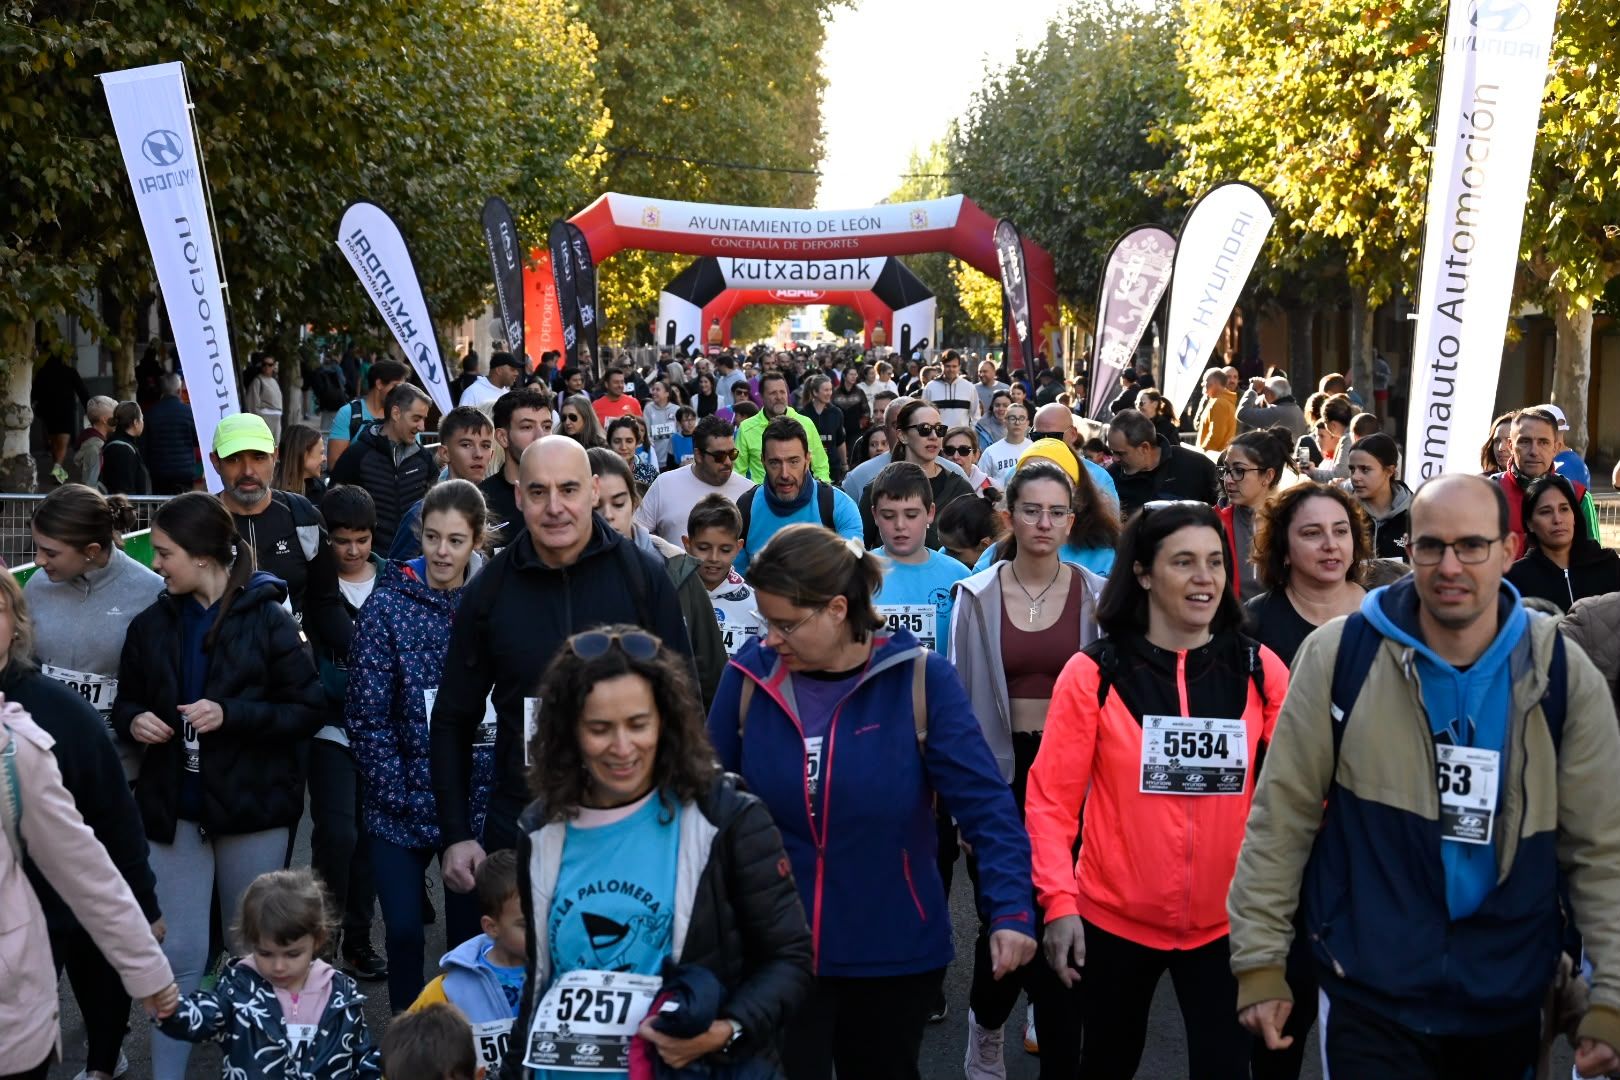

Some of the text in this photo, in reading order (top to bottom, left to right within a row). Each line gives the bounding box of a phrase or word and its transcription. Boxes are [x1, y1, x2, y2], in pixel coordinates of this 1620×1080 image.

[688, 215, 881, 234] AYUNTAMIENTO DE LEÓN
[711, 237, 859, 250] CONCEJALÍA DE DEPORTES
[731, 256, 871, 281] kutxabank
[1193, 211, 1254, 326] HYUNDAI
[1421, 84, 1500, 482] emauto Automoción
[1164, 730, 1229, 759] 5534
[557, 898, 574, 916] LA
[578, 879, 661, 914] PALOMERA
[557, 988, 632, 1025] 5257
